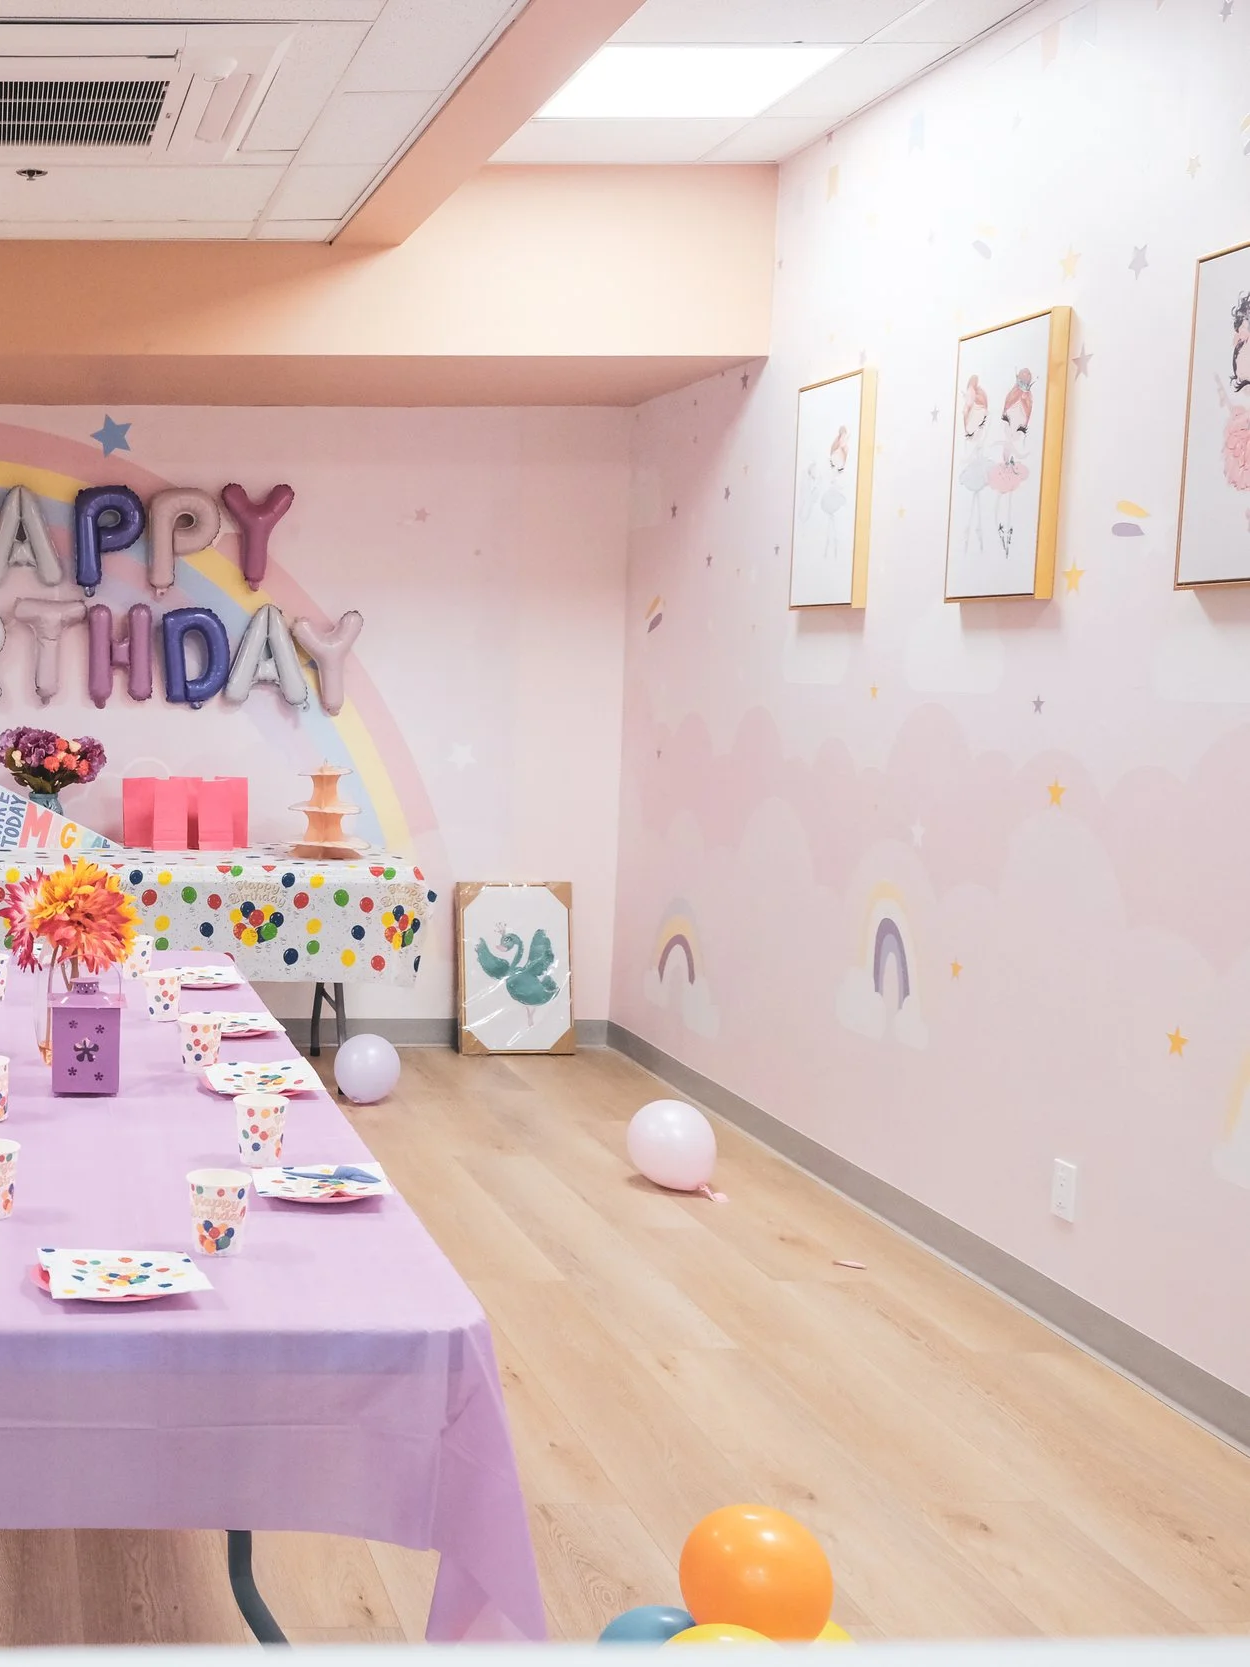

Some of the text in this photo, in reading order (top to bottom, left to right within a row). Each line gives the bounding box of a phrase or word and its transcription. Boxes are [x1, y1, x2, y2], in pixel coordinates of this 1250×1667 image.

[0, 794, 28, 848] TODAY
[235, 880, 281, 896] Happy
[228, 892, 286, 908] Birthday
